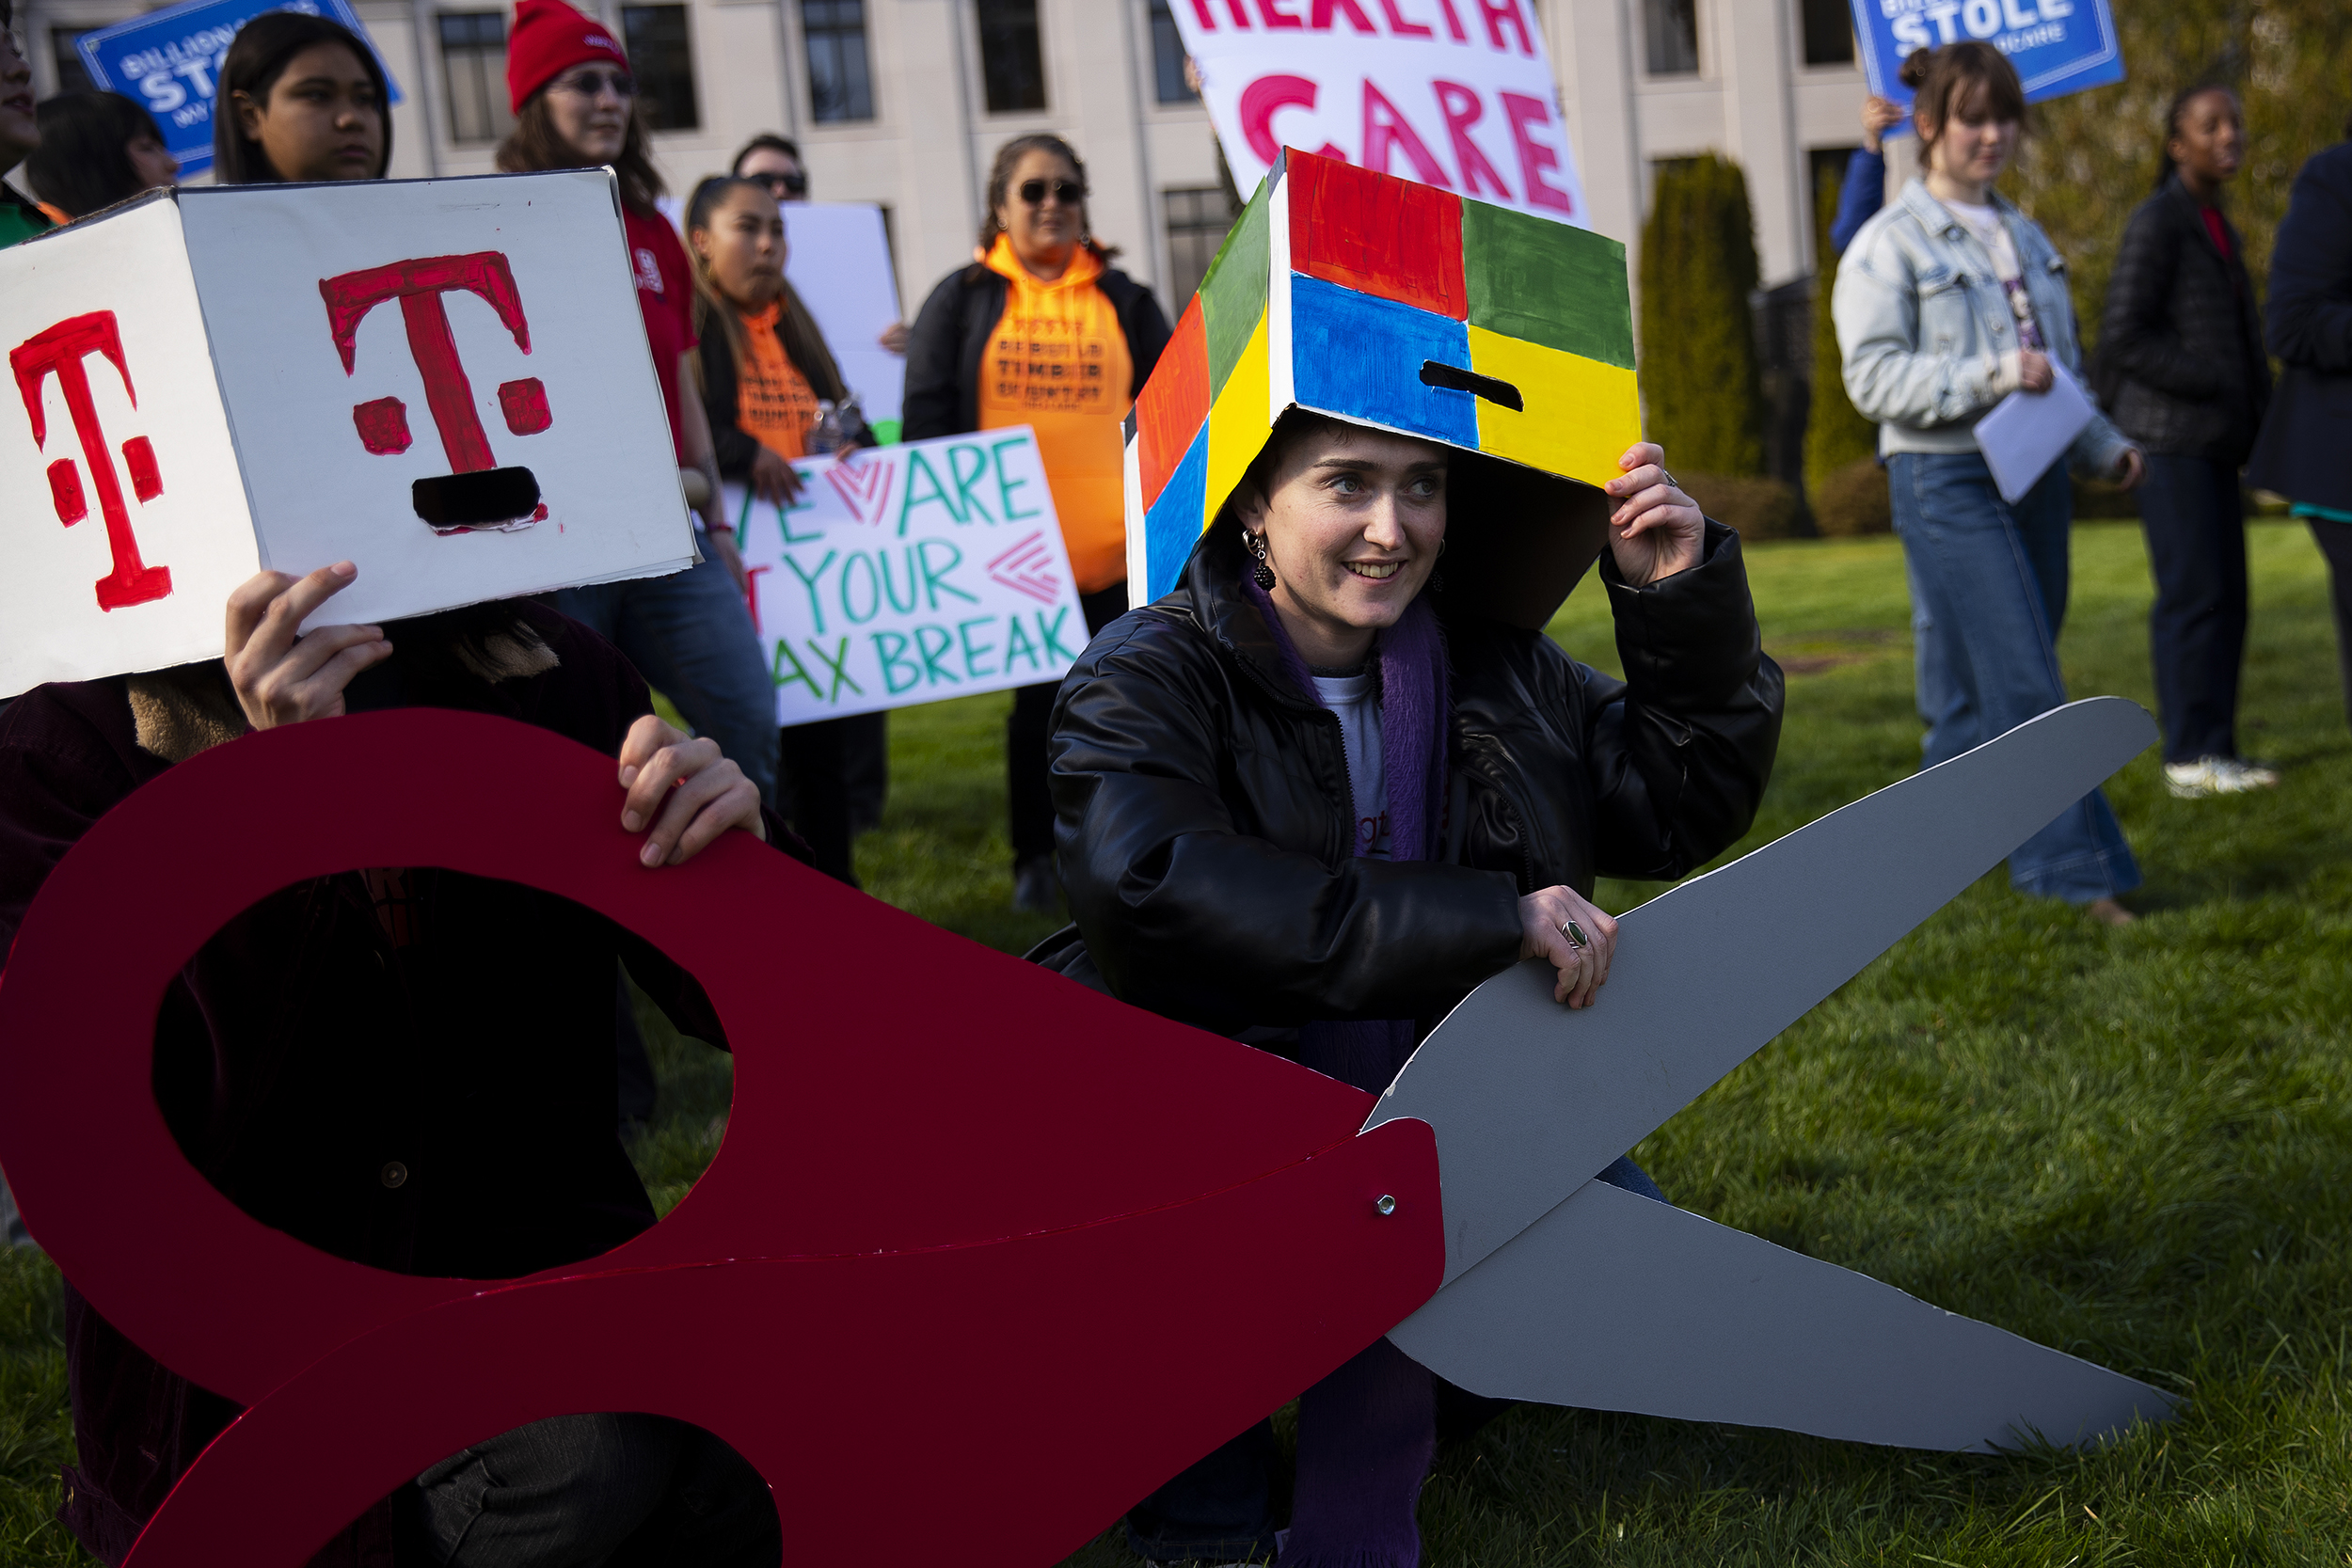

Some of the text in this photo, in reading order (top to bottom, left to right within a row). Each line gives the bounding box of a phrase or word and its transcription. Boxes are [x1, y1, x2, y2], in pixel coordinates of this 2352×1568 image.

[1239, 72, 1573, 215] CARE
[897, 436, 1041, 538] ARE
[782, 537, 981, 636] YOUR
[869, 605, 1078, 696] BREAK
